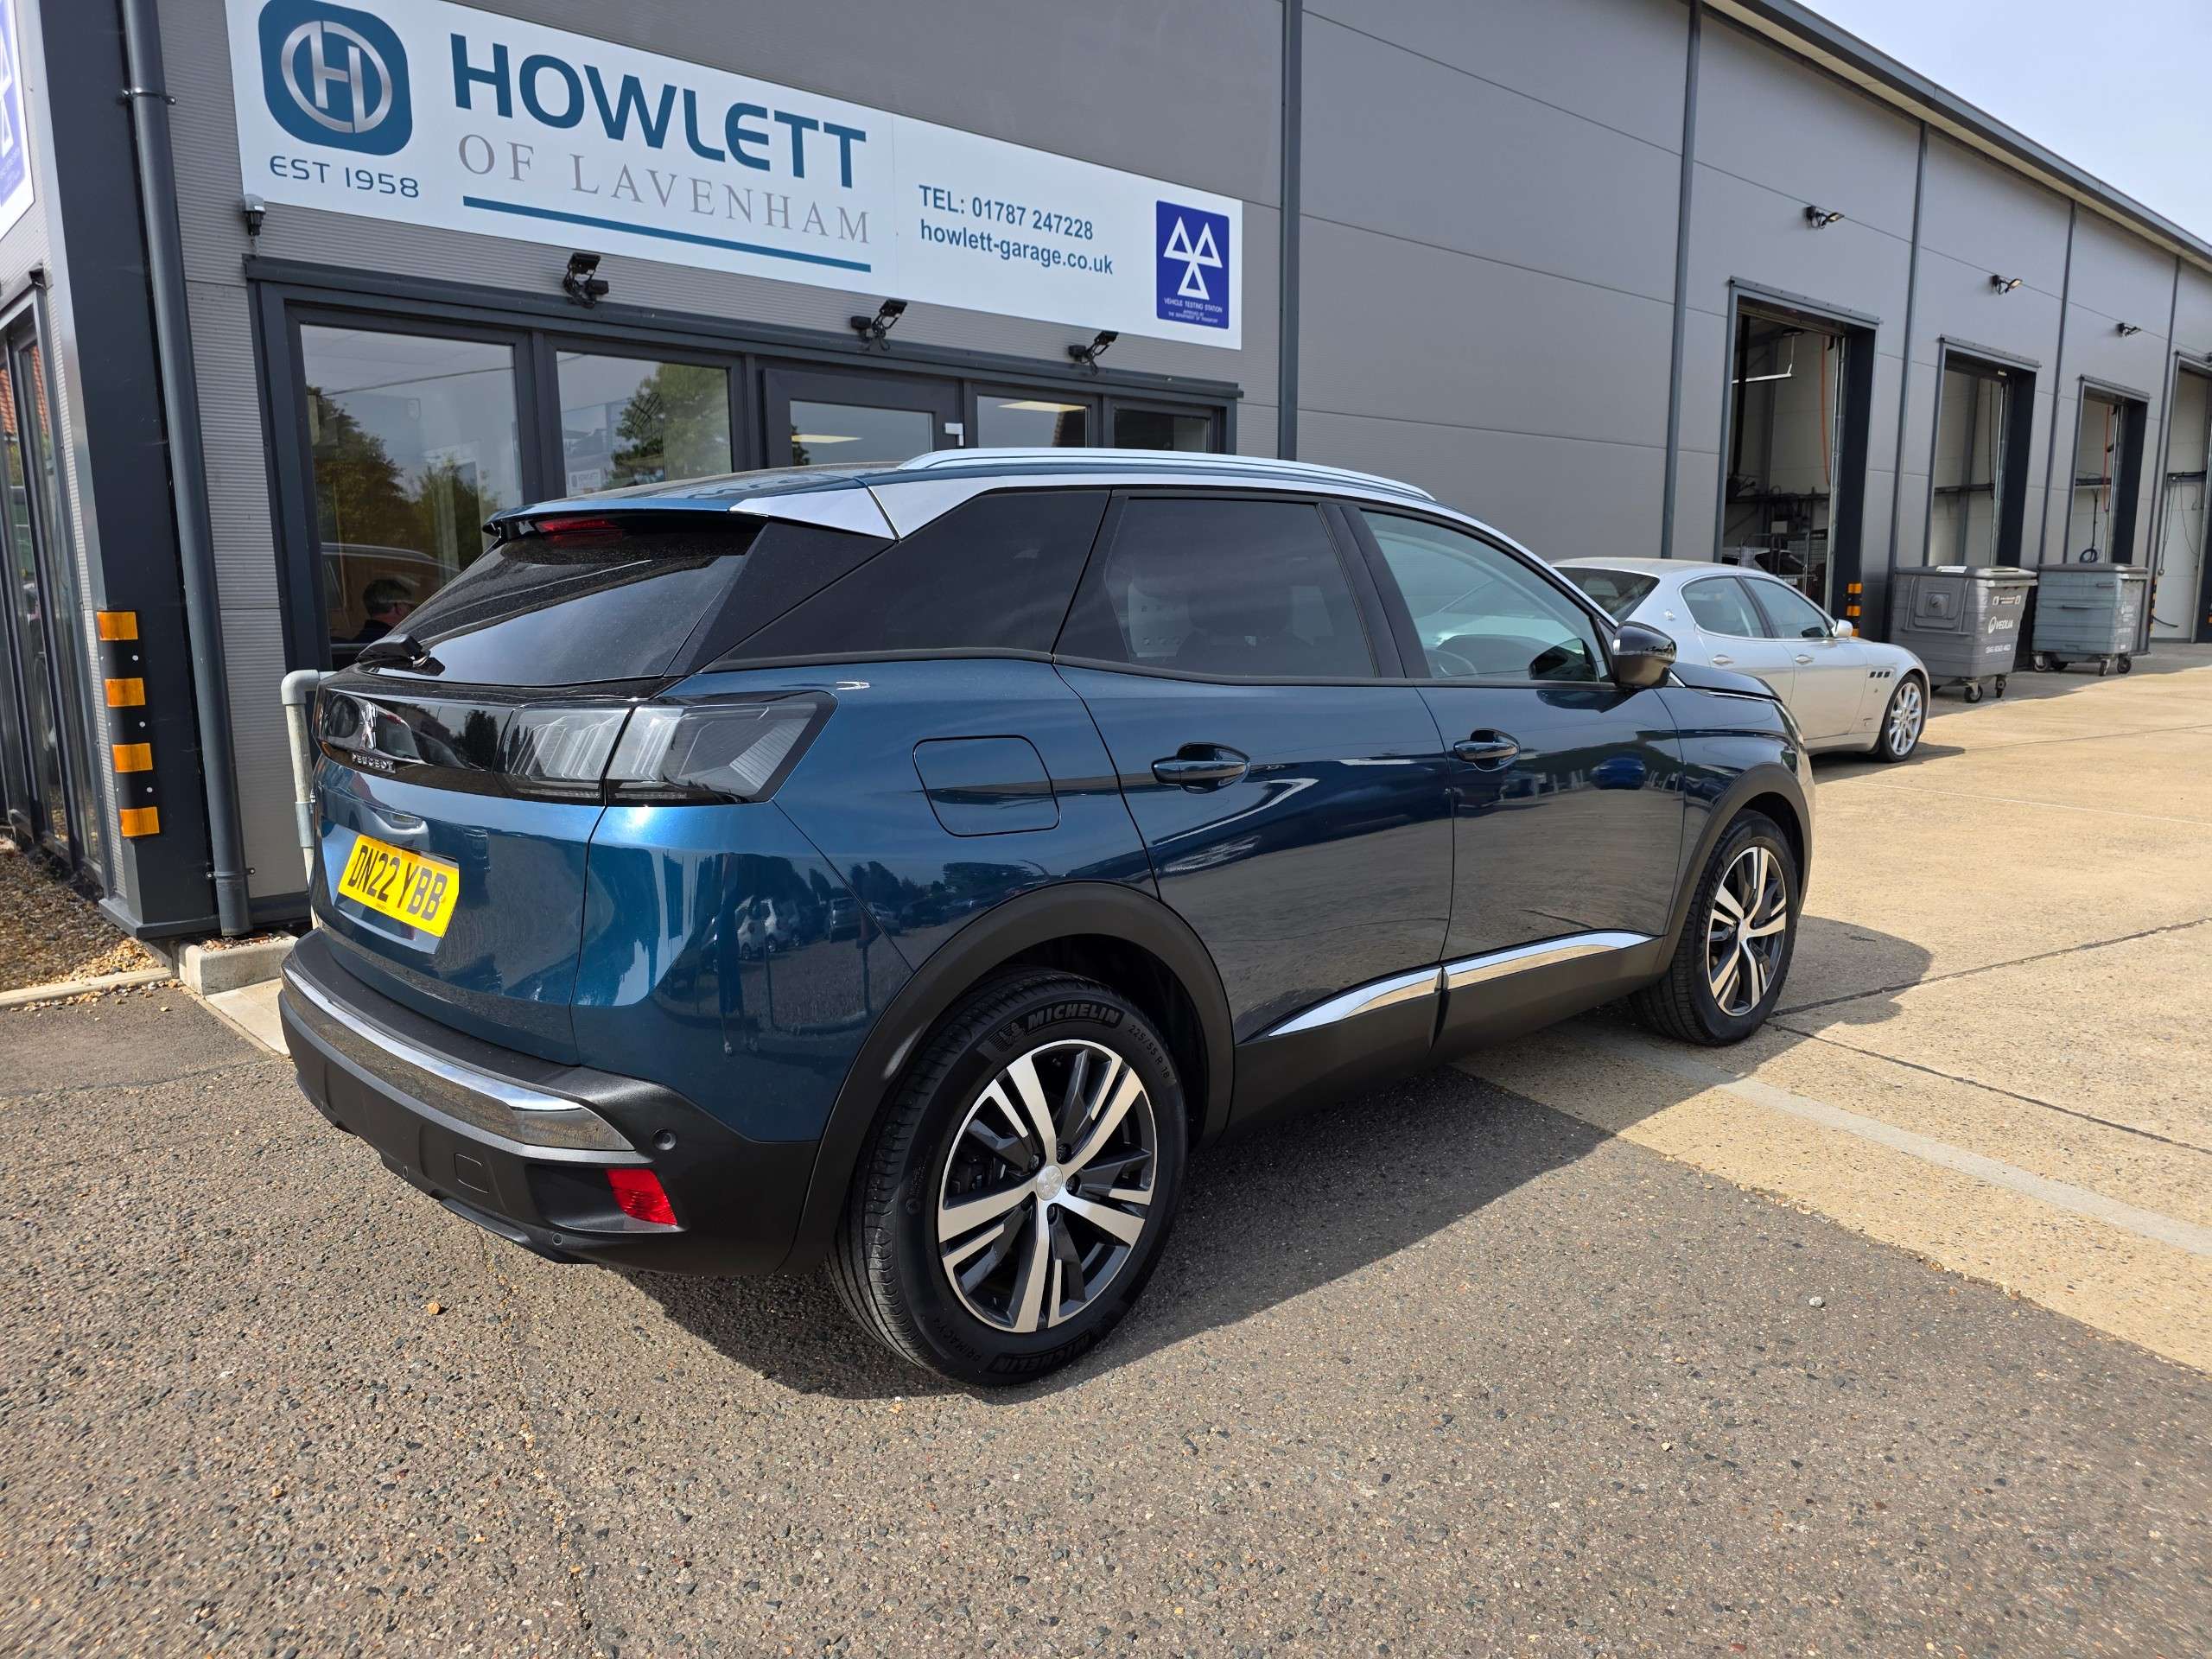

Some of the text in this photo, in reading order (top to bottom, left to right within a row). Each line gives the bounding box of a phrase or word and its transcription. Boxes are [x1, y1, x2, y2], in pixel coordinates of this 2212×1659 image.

[450, 33, 867, 188] HOWLETT
[270, 156, 419, 198] EST 1958
[458, 134, 869, 244] OF LAVENHAM
[918, 185, 1093, 240] TEL: 01787 247228
[921, 219, 1113, 275] howlett-garage.co.uk
[1164, 297, 1183, 307] VEHICLE
[1185, 301, 1204, 310] TESTING
[1205, 304, 1223, 313] STATION
[1995, 620, 2013, 629] VEOLIA
[352, 753, 396, 773] PEUGEOT
[347, 845, 448, 921] DN22 YBB
[1027, 1003, 1121, 1030] MICHELIN
[1128, 1025, 1170, 1078] 225/55 R 18
[939, 1322, 982, 1363] PRIMACY
